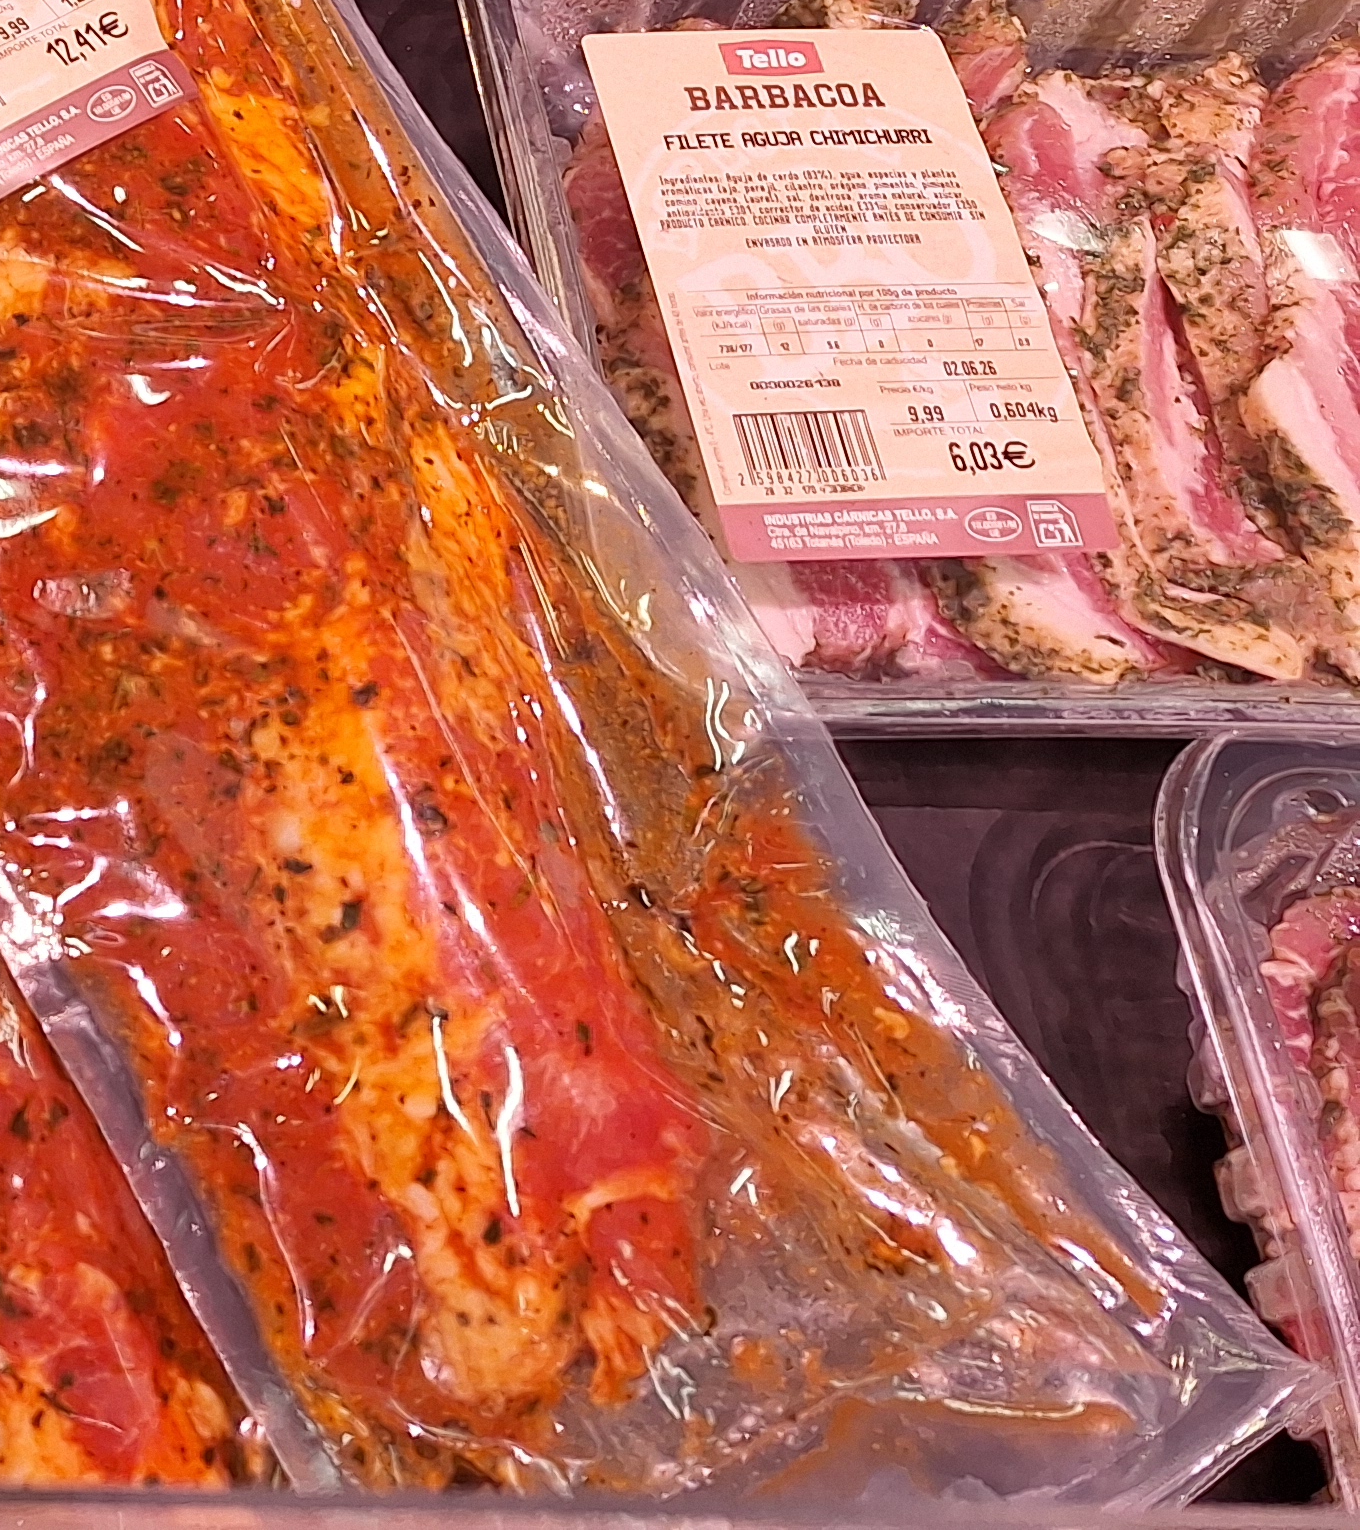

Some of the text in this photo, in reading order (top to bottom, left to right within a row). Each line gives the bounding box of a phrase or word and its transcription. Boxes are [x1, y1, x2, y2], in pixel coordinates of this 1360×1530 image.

[39, 18, 70, 40] TOTAL
[42, 7, 134, 74] 12,41€
[734, 47, 810, 70] Tello
[682, 82, 886, 111] BARBACOA
[25, 112, 64, 140] TELLO,
[58, 102, 82, 122] S.A.
[661, 128, 933, 151] FILETE AGUJA CHIMICHURRI
[941, 359, 998, 378] 02.06.26
[905, 404, 946, 424] 9,99
[987, 400, 1060, 423] 0,604kg
[892, 424, 984, 438] IMPORTE TOTAL
[945, 440, 1040, 475] 6,03€
[762, 506, 960, 528] INDUSTRIAS CÁRNICAS TELLO, S.A.
